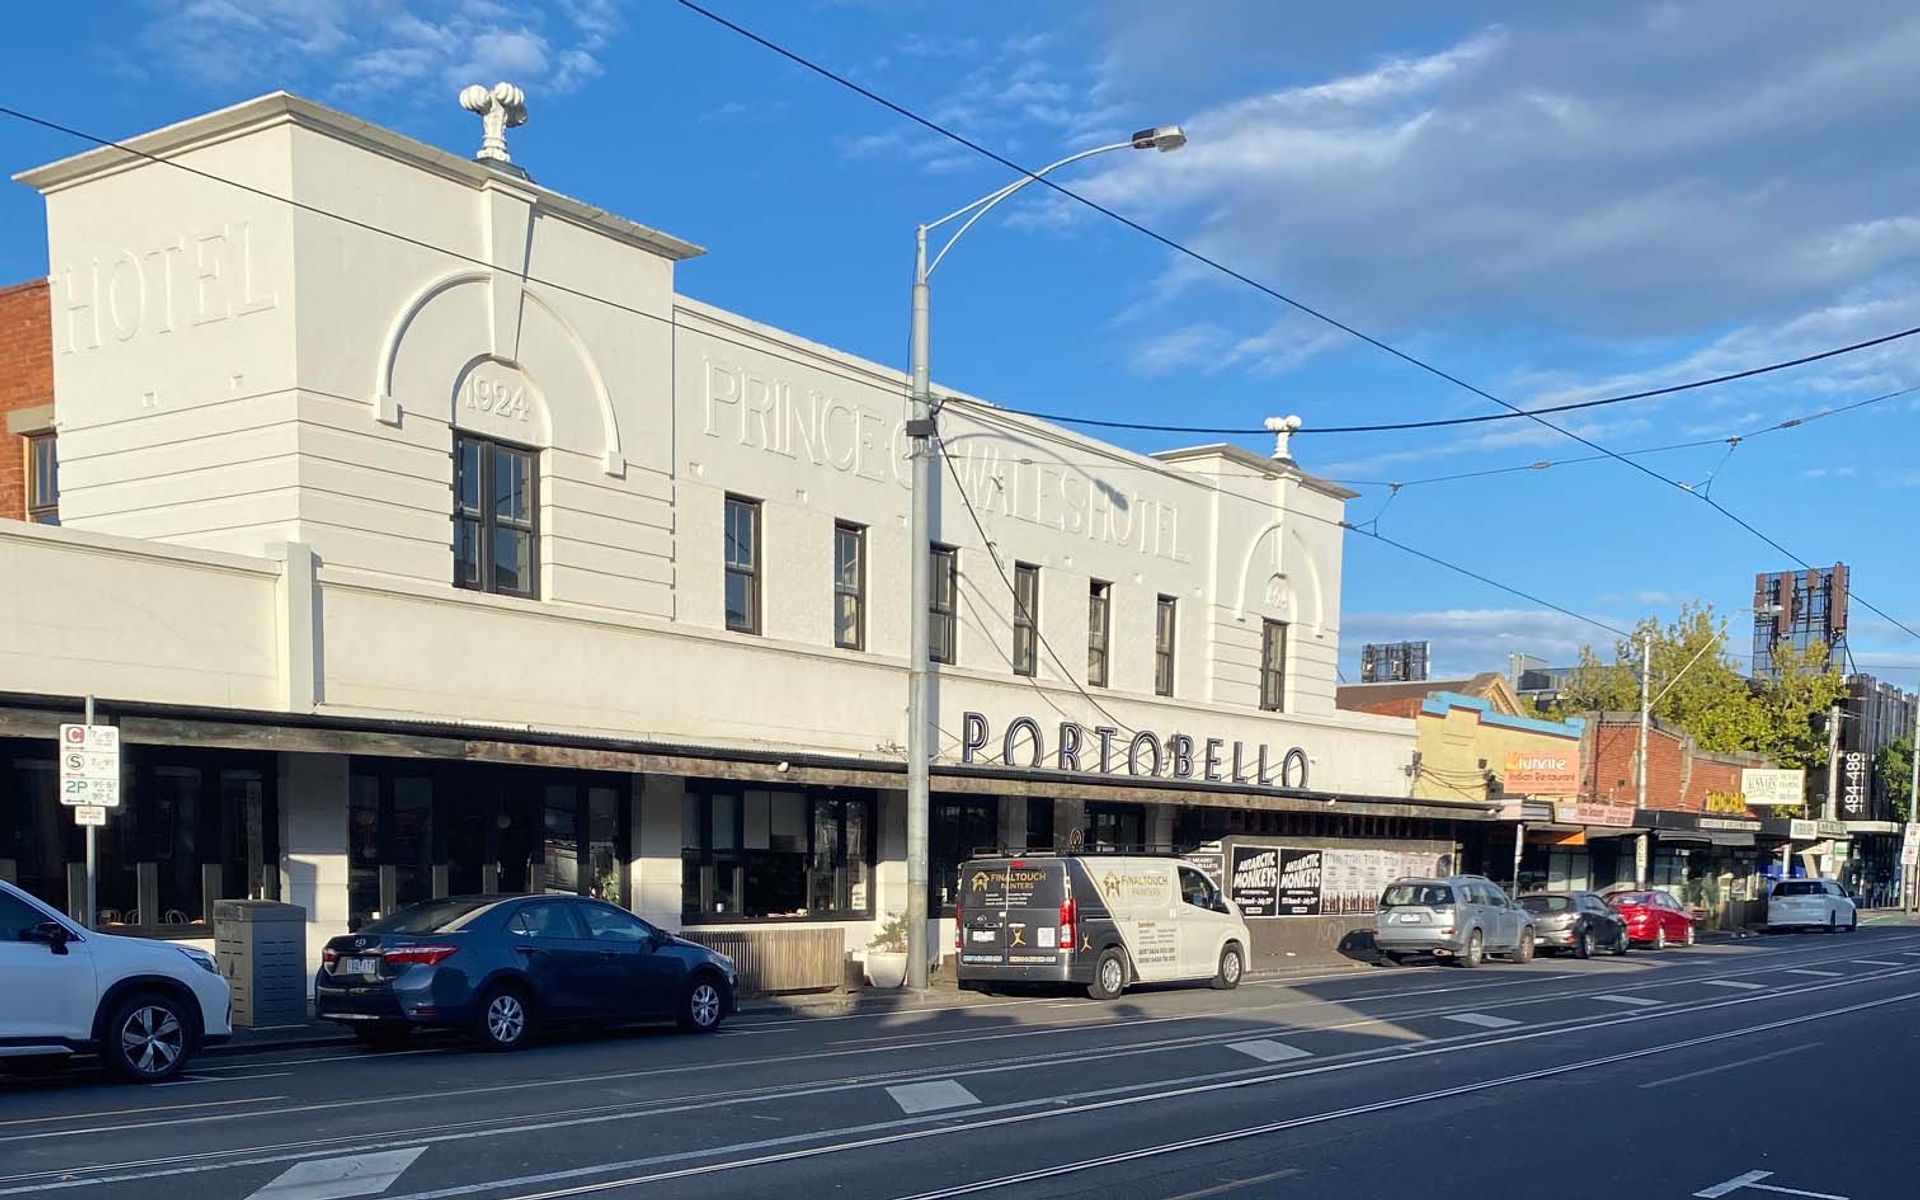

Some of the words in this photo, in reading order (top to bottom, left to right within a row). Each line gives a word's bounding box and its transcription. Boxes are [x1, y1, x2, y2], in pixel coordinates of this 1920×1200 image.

[61, 219, 279, 355] HOTEL
[464, 373, 530, 423] 1924
[702, 354, 886, 484] PRINCE
[1084, 475, 1191, 565] HOTEL
[962, 710, 1311, 789] PORTOBELLO
[70, 755, 81, 768] S
[65, 780, 88, 794] 2P
[1845, 751, 1861, 814] 484-486
[1238, 852, 1276, 872] ANTARCTIC
[1284, 853, 1320, 873] ANTARCTIC
[1233, 867, 1278, 889] MONKEYS
[1280, 868, 1321, 889] MONKEYS
